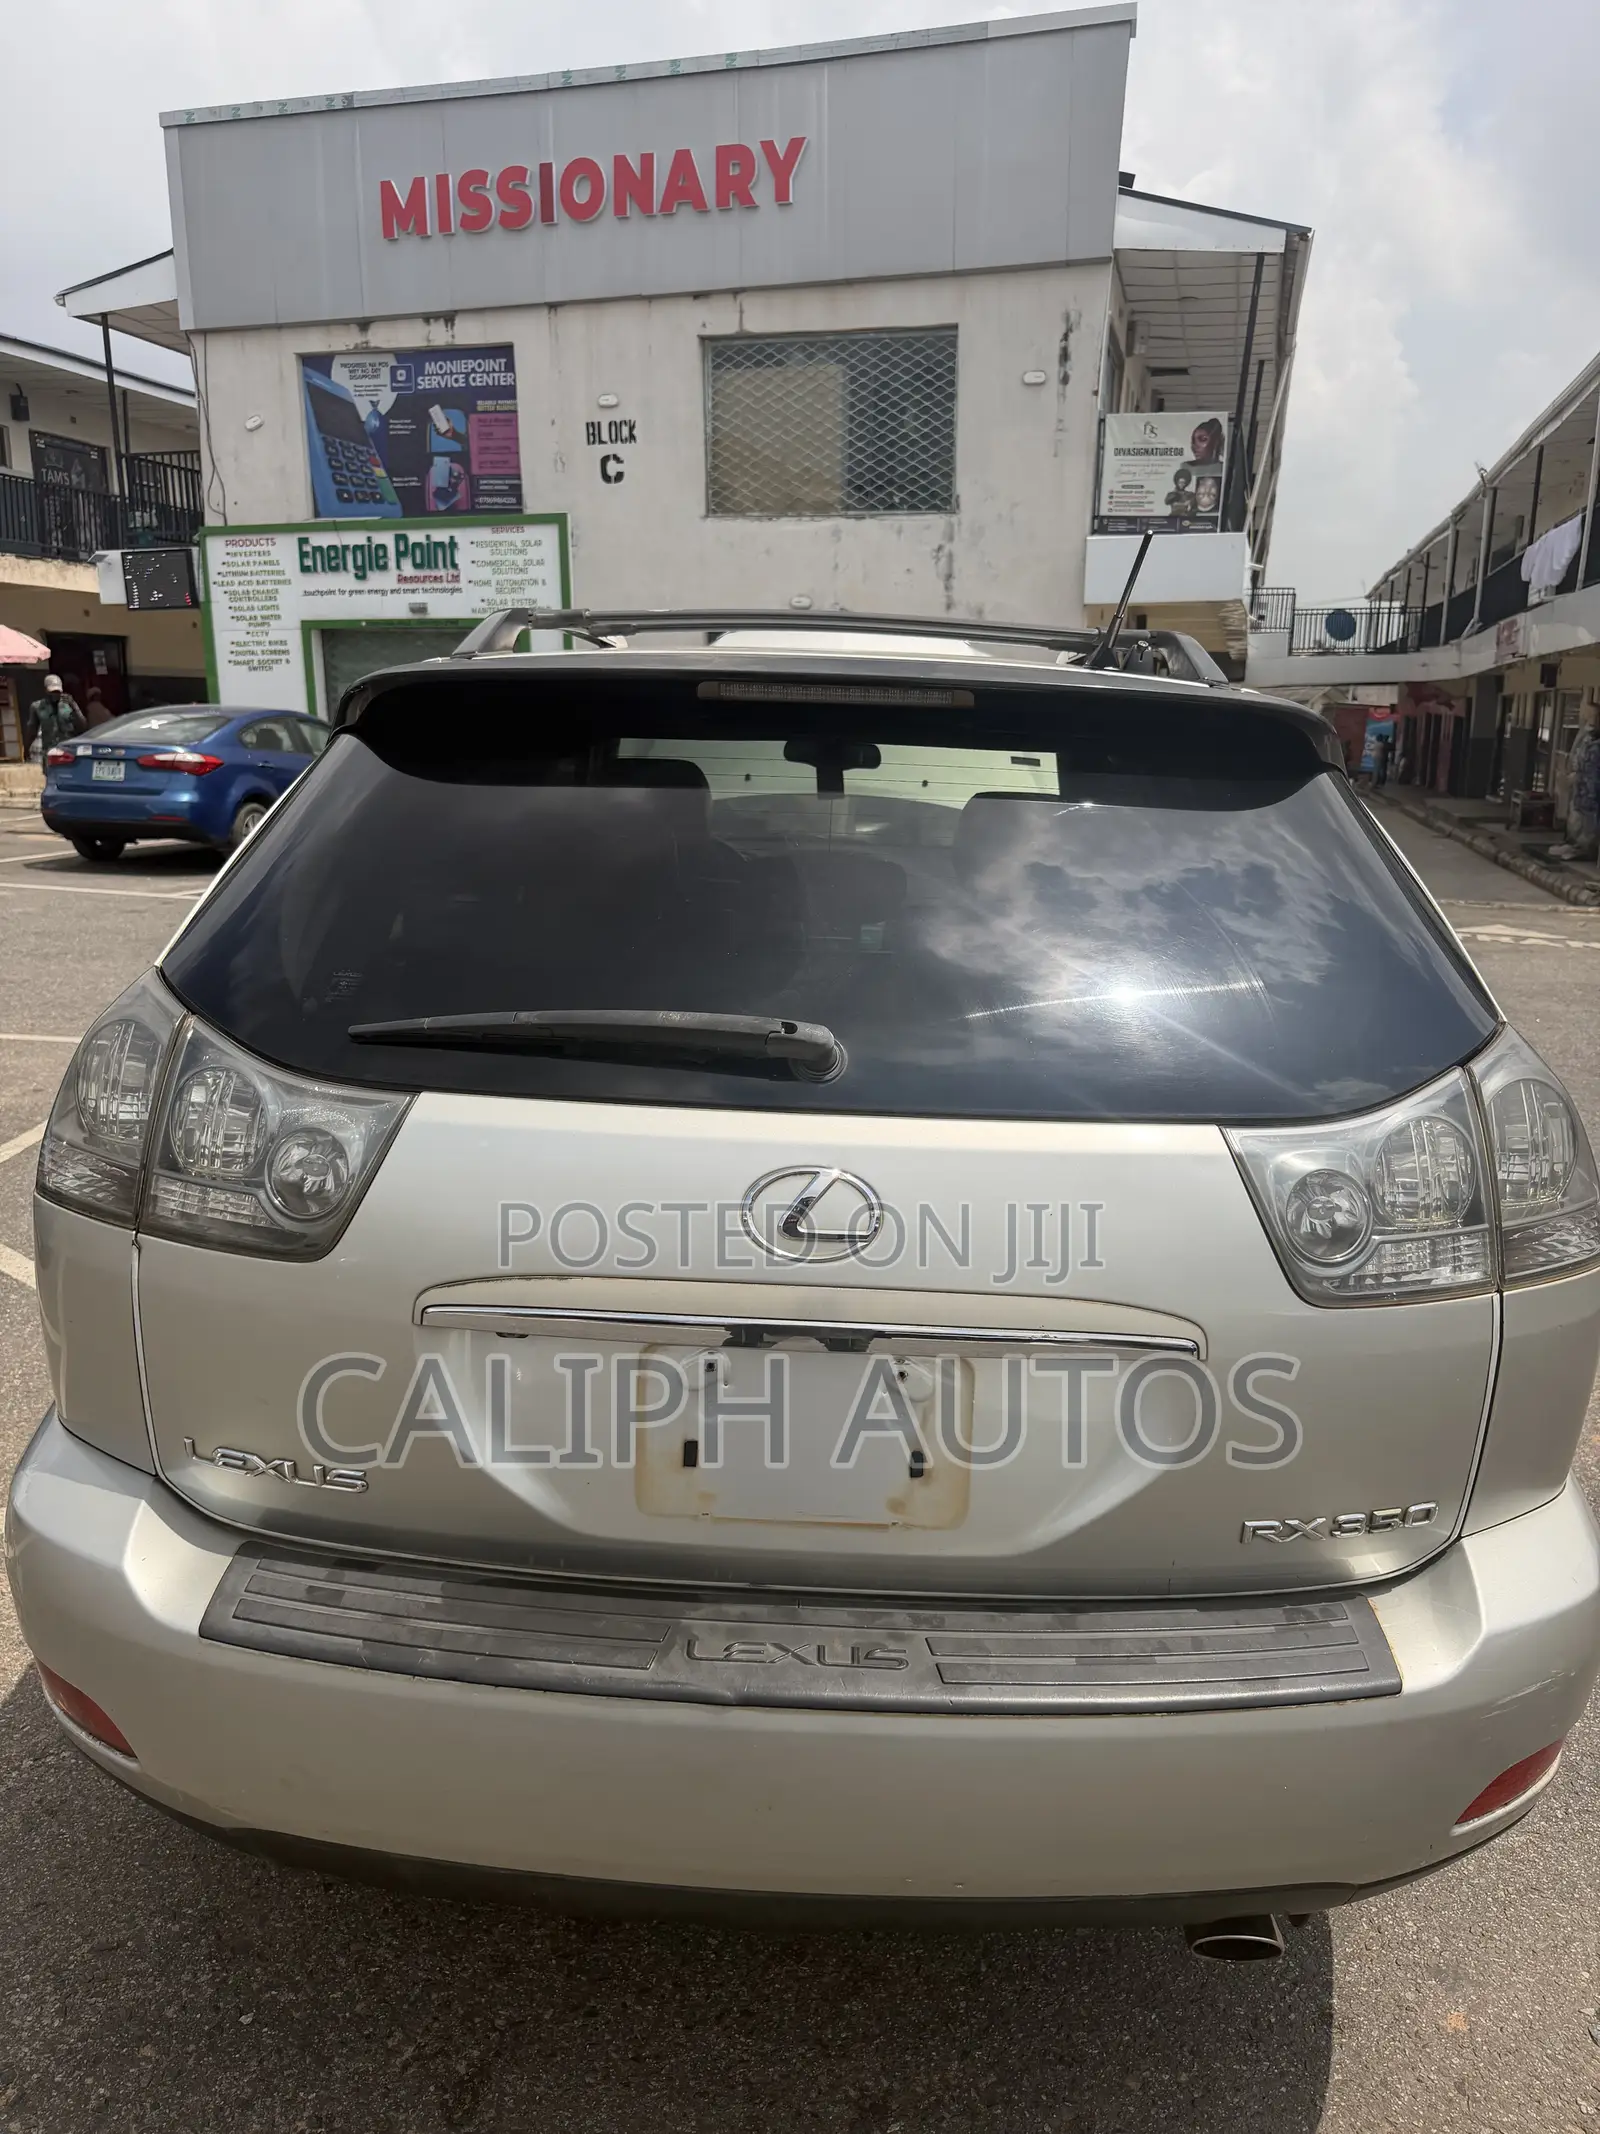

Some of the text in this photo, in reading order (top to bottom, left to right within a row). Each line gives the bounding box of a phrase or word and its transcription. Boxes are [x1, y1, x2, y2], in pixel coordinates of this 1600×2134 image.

[380, 136, 808, 241] MISSIONARY
[424, 358, 507, 375] MONIEPOINT
[417, 372, 515, 389] SERVICE CENTER
[586, 419, 637, 446] BLOCK
[600, 453, 625, 484] C
[41, 468, 70, 485] TAM'S
[491, 526, 525, 534] SERVICES
[225, 537, 276, 547] PRODUCTS
[476, 539, 542, 548] RESIDENTIAL SOLAR
[298, 533, 460, 580] Energie Point
[490, 548, 528, 556] SOLUTIONS
[226, 559, 280, 568] SOLAR PANELS
[476, 558, 545, 568] COMMERCIAL SOLAR
[250, 569, 286, 577] BATTERIES
[491, 567, 529, 576] SOLUTIONS
[218, 579, 236, 587] LEAD
[256, 578, 292, 586] BATTERIES
[397, 572, 460, 584] Resources Ltd
[473, 579, 492, 587] HOME
[496, 579, 539, 587] AUTOMATION
[338, 588, 347, 596] for
[348, 589, 366, 597] green
[367, 588, 388, 597] energy
[390, 587, 401, 595] and
[402, 587, 420, 595] smart
[421, 586, 463, 596] technologies
[495, 586, 526, 595] SECURITY
[486, 598, 537, 606] SOLAR SYSTEM
[184, 1436, 369, 1492] LEXUS
[686, 1639, 910, 1671] LEXUS
